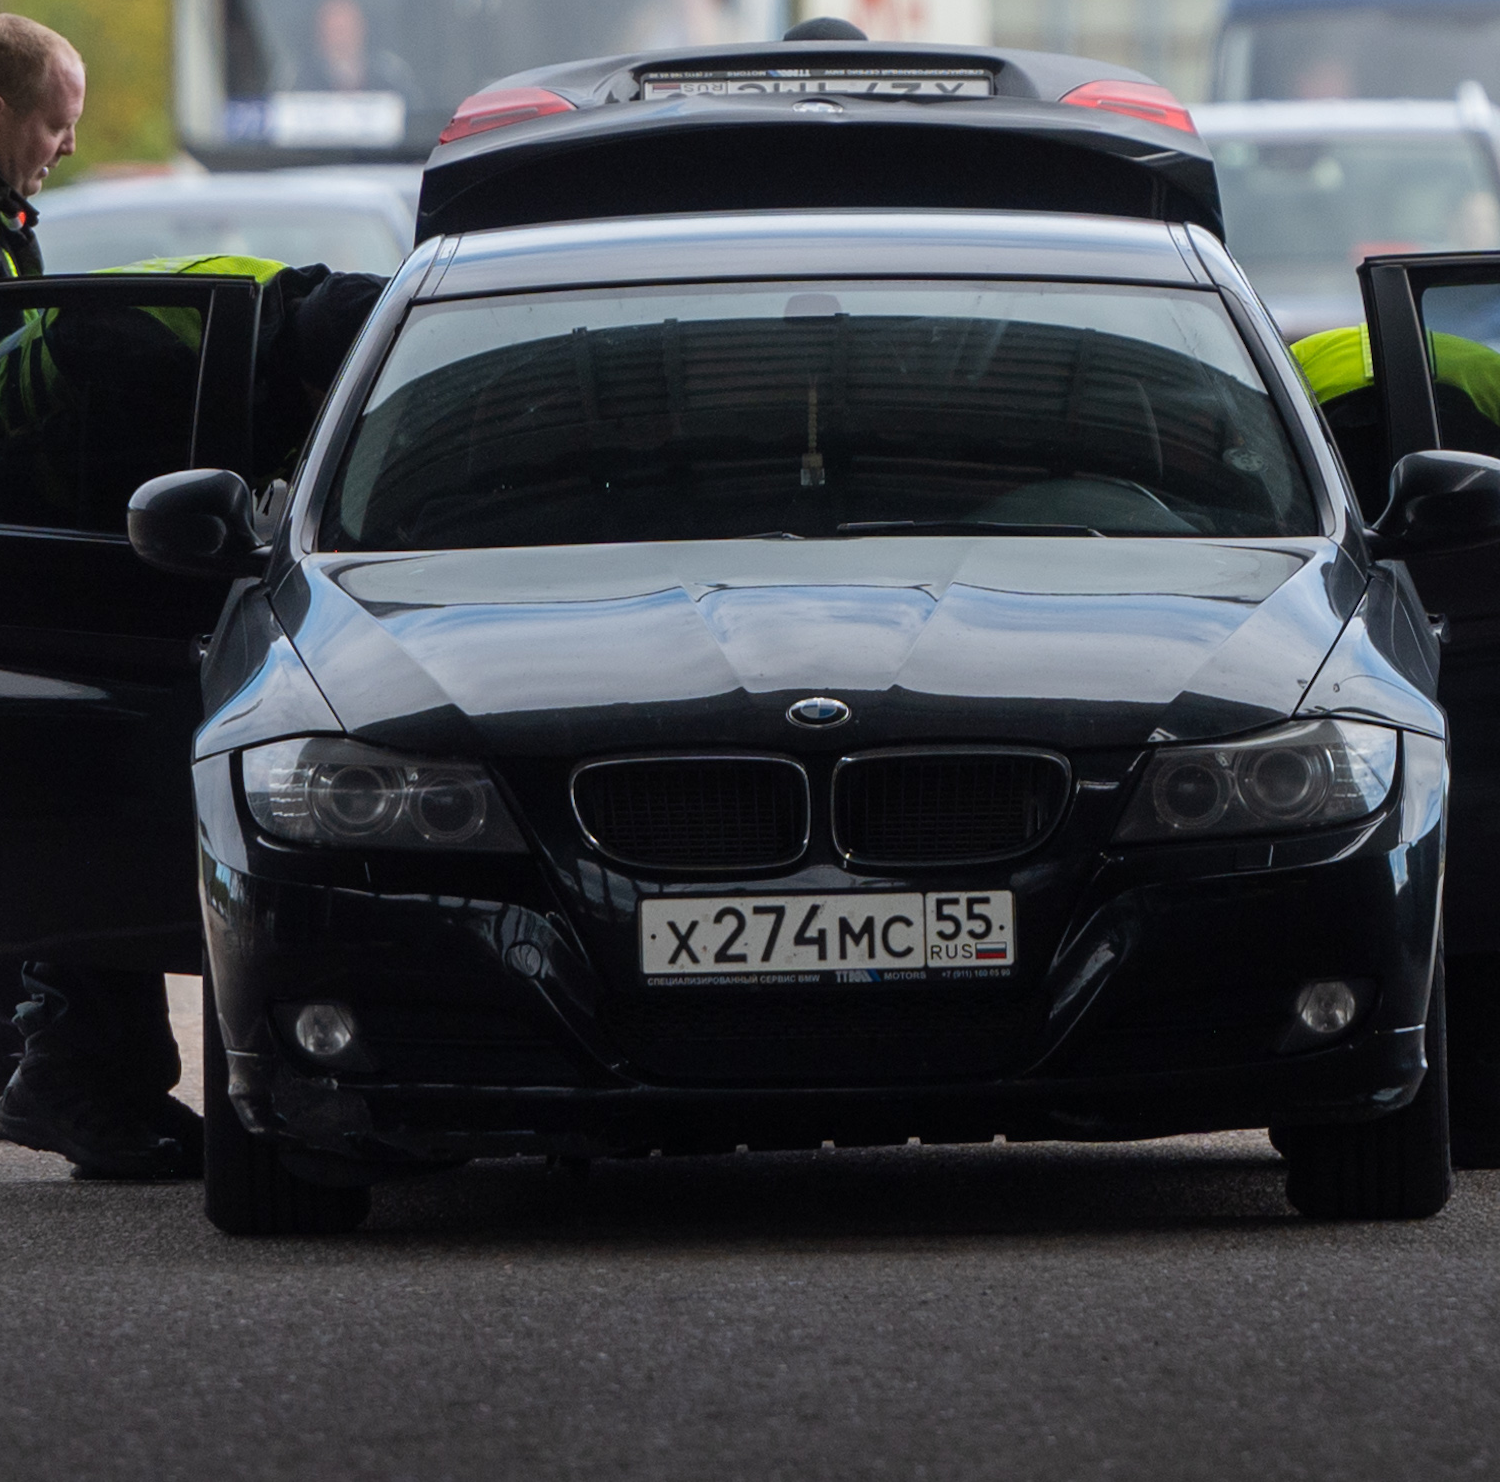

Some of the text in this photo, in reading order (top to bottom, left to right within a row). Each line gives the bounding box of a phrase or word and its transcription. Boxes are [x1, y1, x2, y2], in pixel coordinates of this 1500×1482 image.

[683, 82, 723, 92] RUS
[666, 897, 993, 965] X274MC 55
[930, 943, 974, 960] RUS
[759, 974, 796, 984] СЕРВИС
[798, 973, 821, 983] BMW
[883, 970, 927, 980] MOTORS
